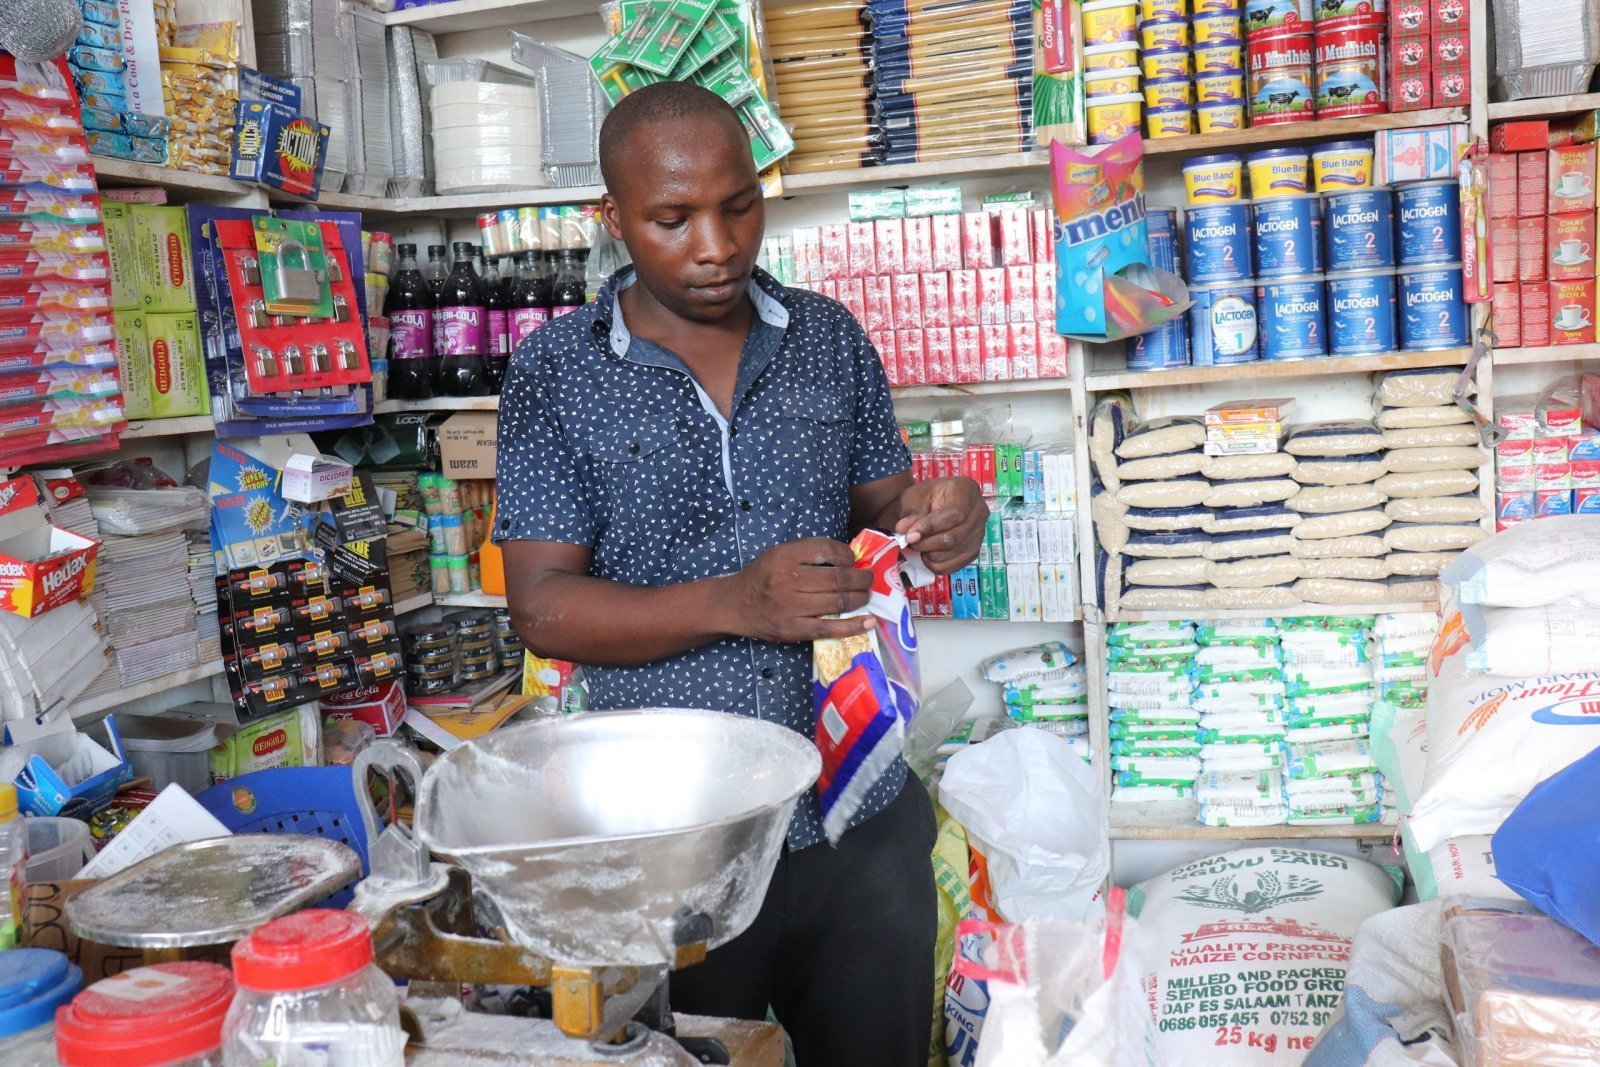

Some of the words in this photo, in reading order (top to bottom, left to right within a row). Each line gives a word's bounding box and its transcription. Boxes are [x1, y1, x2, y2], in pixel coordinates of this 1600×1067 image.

[123, 18, 134, 41] Dry
[1044, 7, 1054, 48] Colgate
[126, 45, 135, 56] &
[1325, 40, 1376, 60] Mudhish
[1252, 54, 1262, 70] Al
[128, 59, 138, 88] Cool
[242, 118, 258, 155] ACTION
[280, 129, 318, 166] ACTION
[1561, 152, 1586, 160] CHAI
[1272, 166, 1291, 174] Blue
[1322, 160, 1340, 168] Blue
[1342, 158, 1363, 166] Band
[1072, 168, 1098, 178] mentos
[1193, 173, 1212, 182] Blue
[1213, 172, 1234, 180] Band
[1333, 210, 1378, 228] LACTOGEN
[1402, 204, 1448, 222] LACTOGEN
[1192, 223, 1236, 241] LACTOGEN
[1256, 217, 1298, 236] LACTOGEN
[1432, 226, 1444, 242] 2
[1284, 240, 1295, 256] 2
[1364, 232, 1376, 248] 2
[170, 236, 180, 285] REDGOLD
[1222, 246, 1233, 260] 2
[1464, 234, 1474, 278] Colgate
[1334, 294, 1378, 312] LACTOGEN
[1406, 288, 1454, 306] LACTOGEN
[1216, 310, 1254, 324] LACTOGEN
[1275, 300, 1318, 317] LACTOGEN
[1364, 318, 1376, 332] 2
[1439, 311, 1450, 326] 2
[1308, 322, 1317, 337] 2
[1234, 332, 1242, 350] 1
[156, 341, 168, 392] REDGOLD
[129, 383, 134, 392] 25
[396, 416, 424, 424] LOCK
[450, 460, 478, 468] azam
[41, 550, 89, 596] Hedex
[460, 620, 476, 628] BLACK
[266, 690, 284, 700] GLUE
[254, 731, 286, 754] REDGOLD
[254, 758, 276, 768] TOMATO
[20, 770, 36, 790] Panadol
[1270, 849, 1349, 864] BORA
[1171, 856, 1264, 883] NGUVU
[1273, 854, 1349, 870] ZAIDI
[1170, 943, 1258, 956] QUALITY
[1170, 952, 1236, 968] MAIZE
[1167, 972, 1231, 989] MILLED
[1236, 970, 1271, 983] AND
[1276, 968, 1346, 980] PACKED
[1166, 984, 1238, 1002] SEMBO
[1244, 980, 1298, 994] FOOD
[1200, 1000, 1219, 1012] ES
[1224, 994, 1291, 1010] SALAAM
[1159, 1016, 1196, 1032] 0686
[1200, 1013, 1228, 1027] 055
[1270, 1011, 1309, 1026] 0752
[1214, 1026, 1242, 1046] 25
[1248, 1032, 1278, 1054] kg
